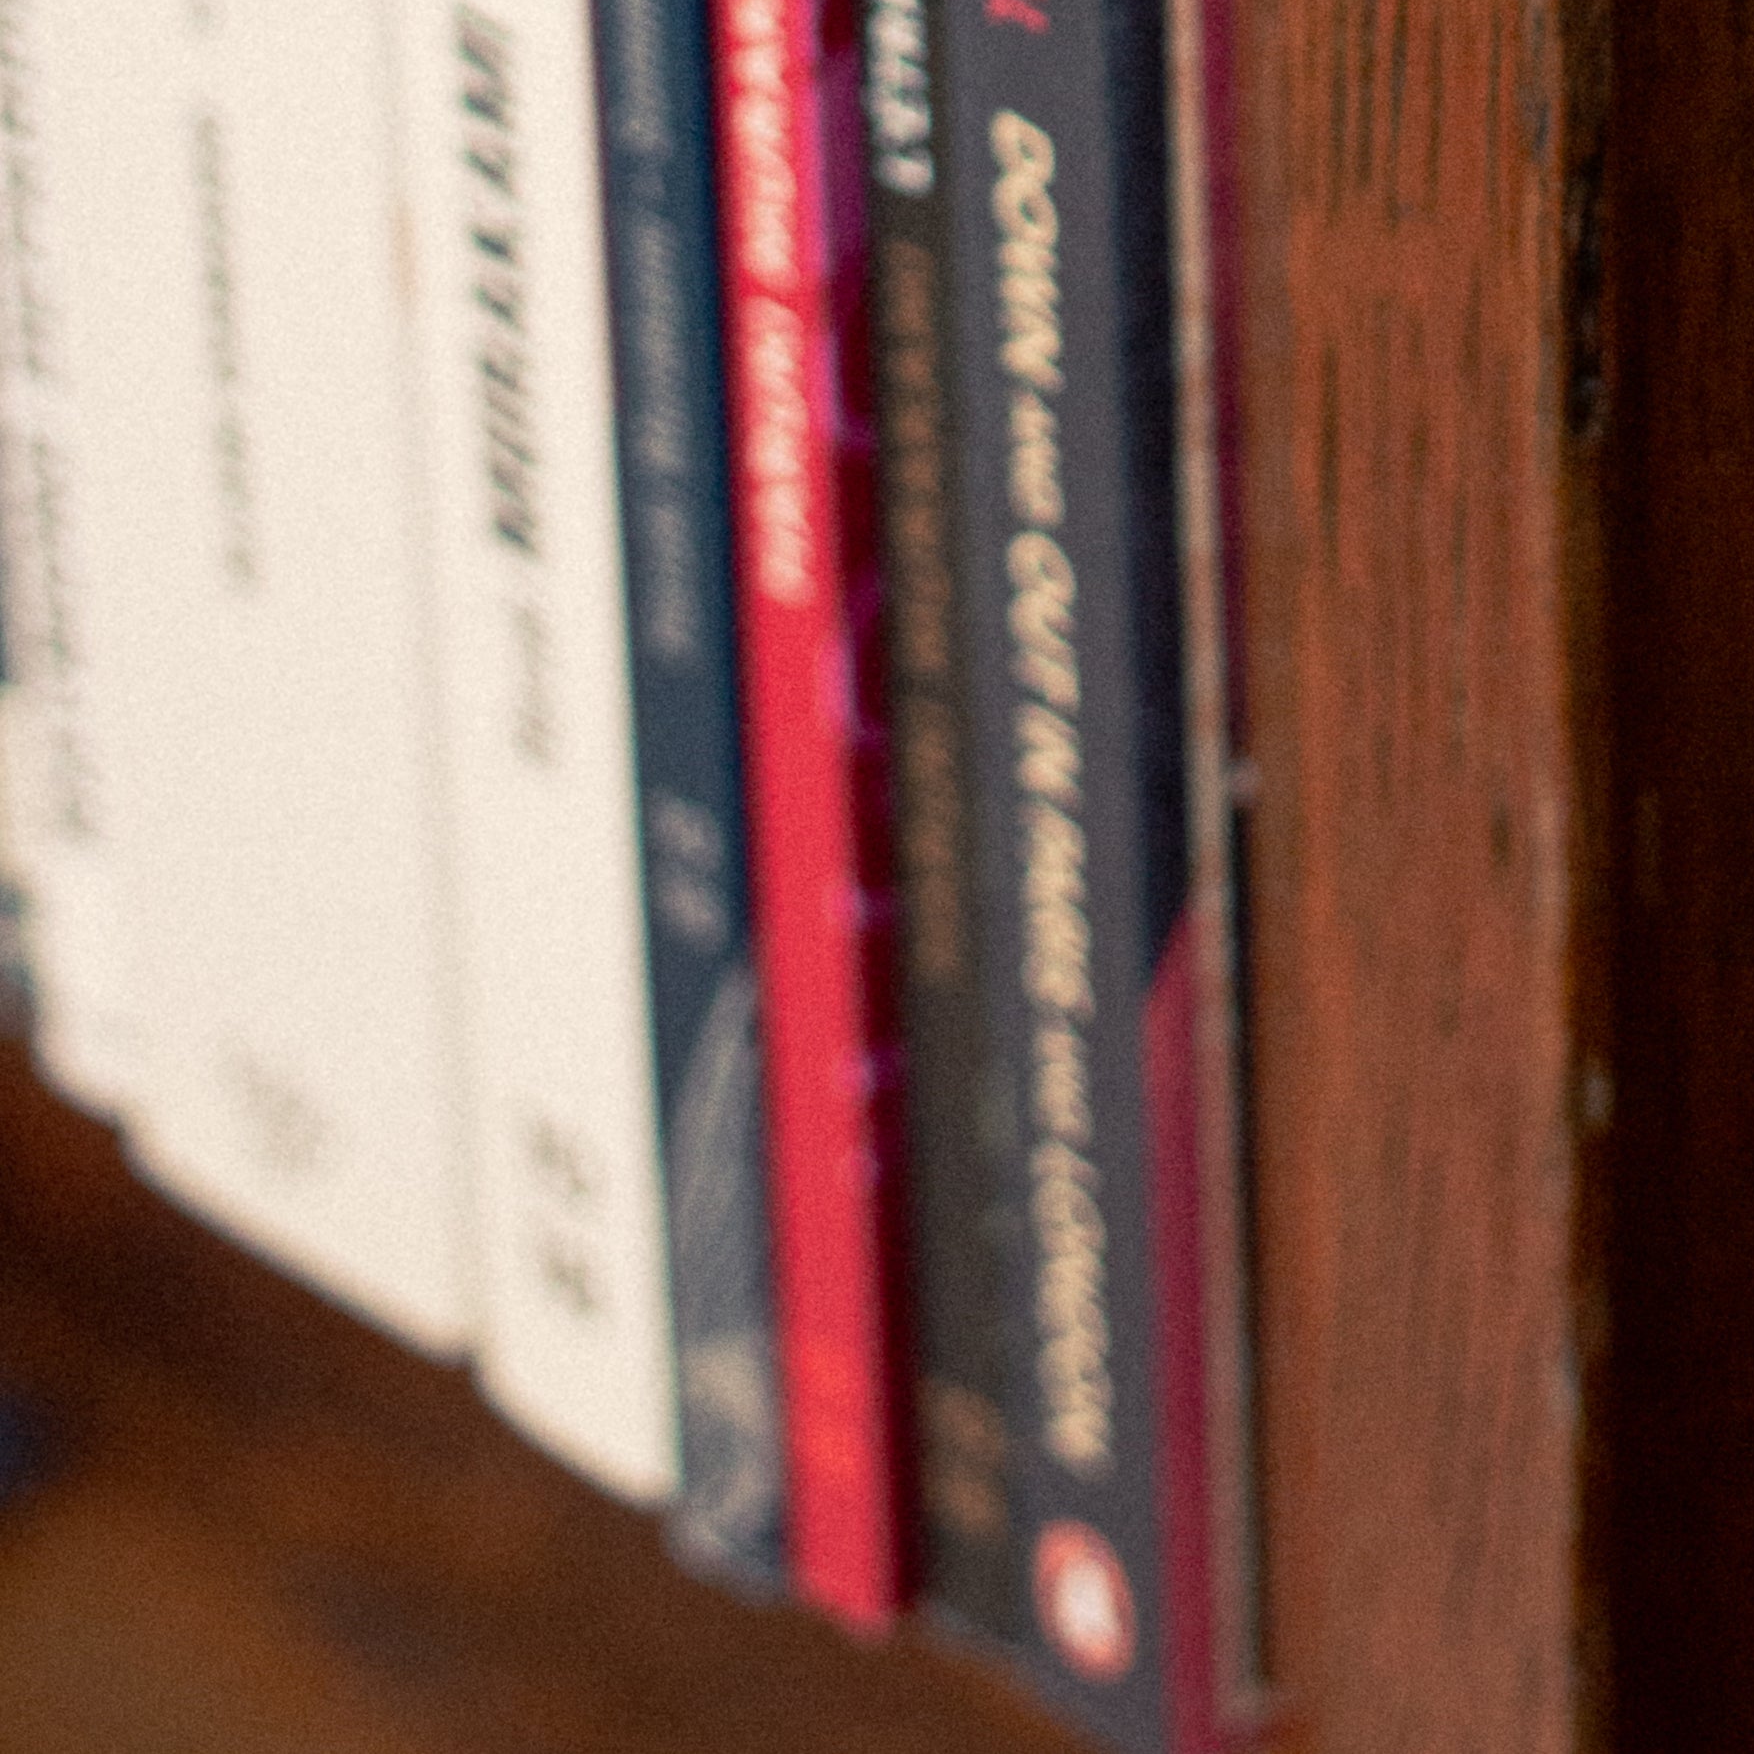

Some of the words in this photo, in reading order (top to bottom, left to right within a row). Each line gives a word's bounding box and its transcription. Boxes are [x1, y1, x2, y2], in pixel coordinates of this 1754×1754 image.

[990, 107, 1066, 392] DOWN
[1006, 528, 1082, 715] OUT
[1014, 698, 1084, 818] IN
[1030, 1139, 1114, 1475] LONDON
